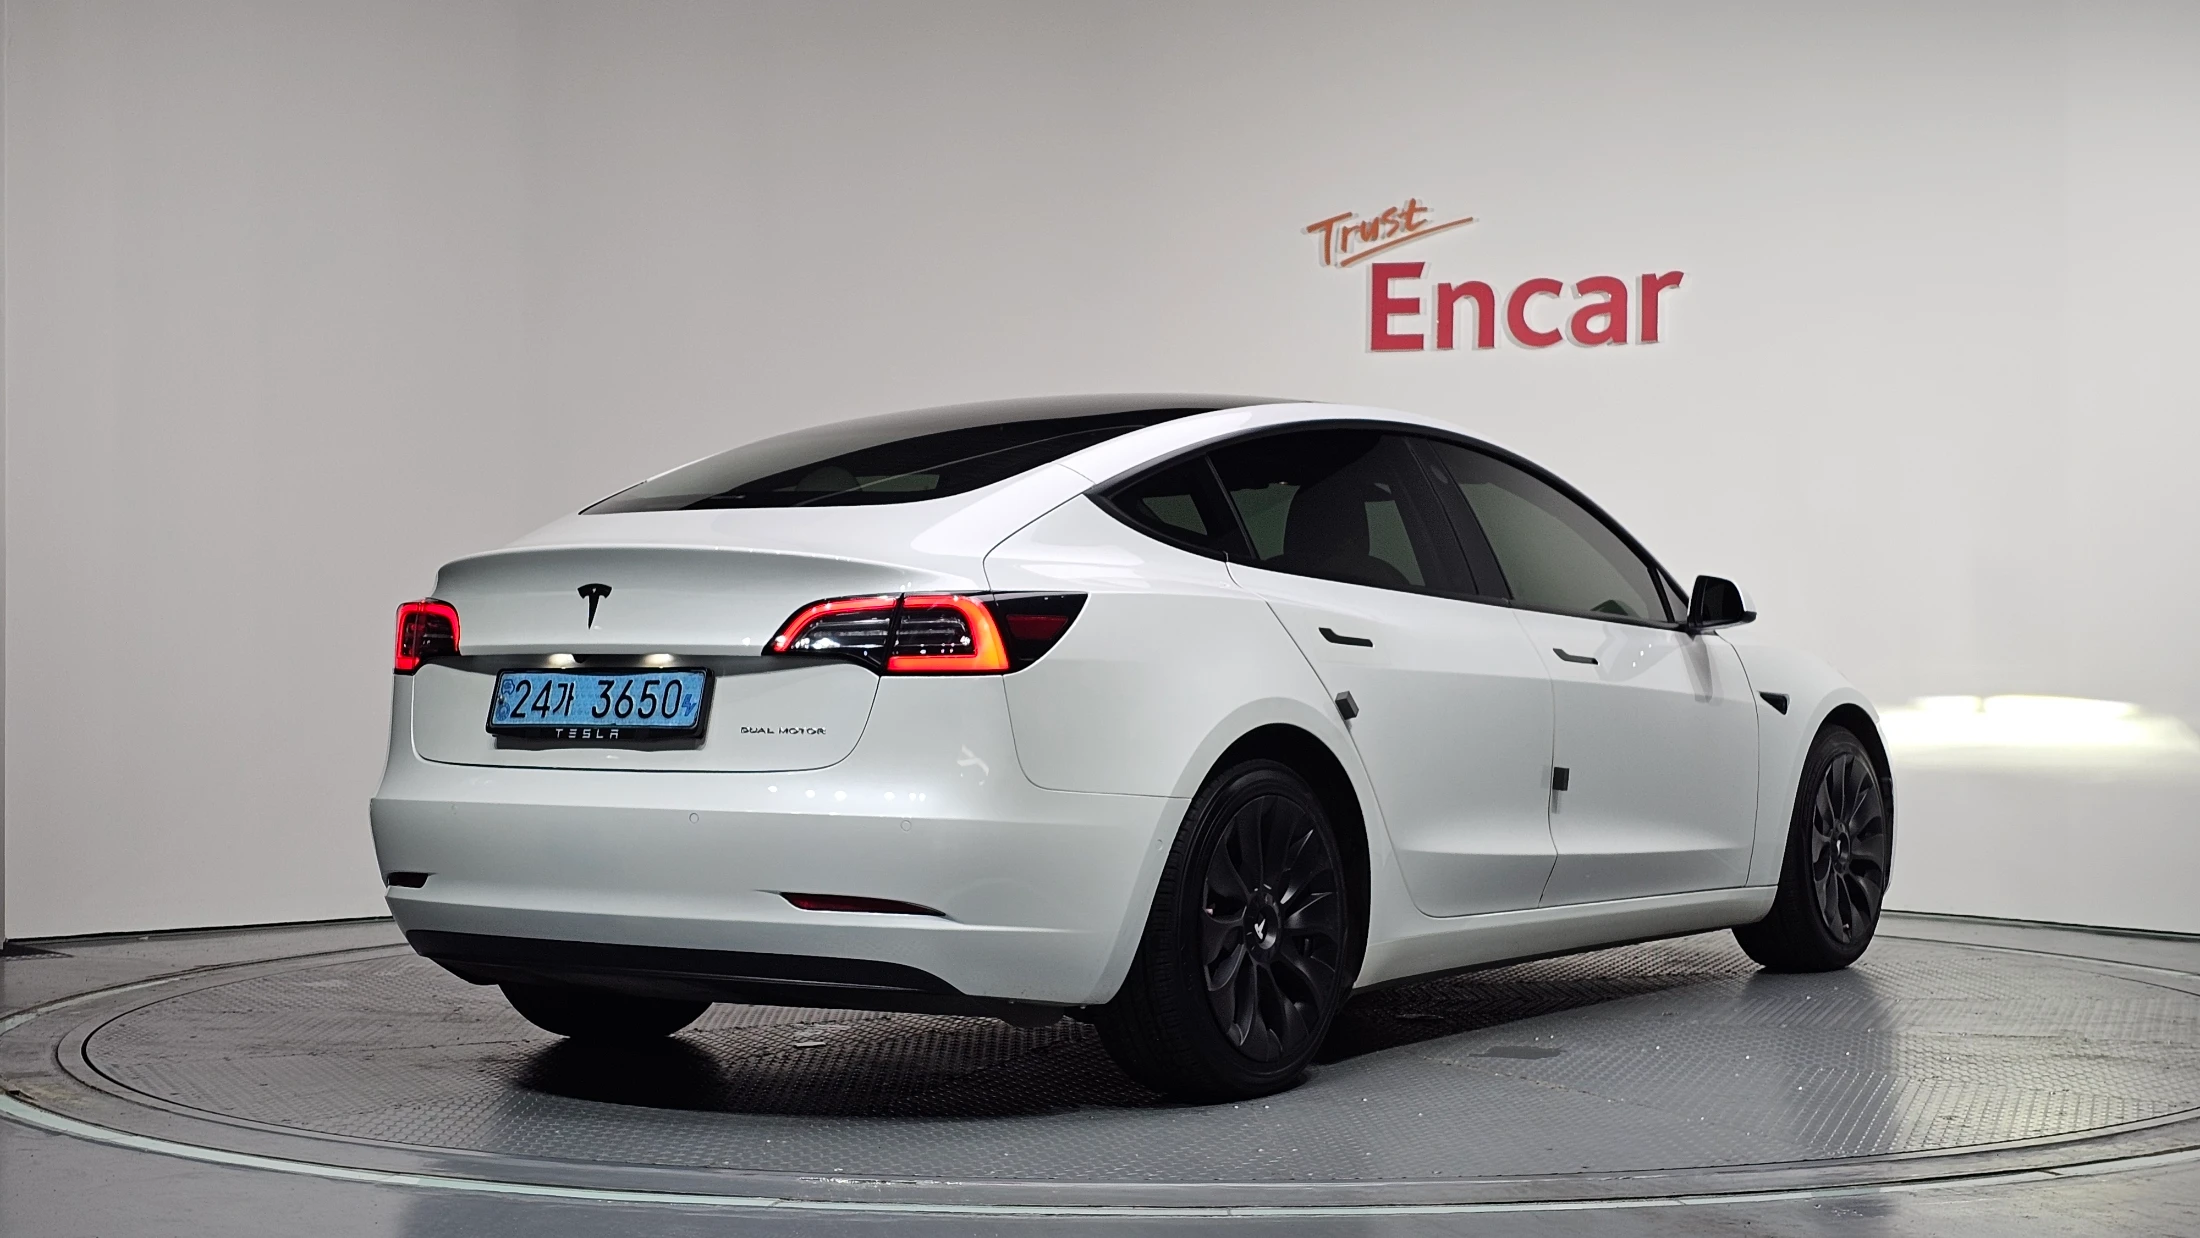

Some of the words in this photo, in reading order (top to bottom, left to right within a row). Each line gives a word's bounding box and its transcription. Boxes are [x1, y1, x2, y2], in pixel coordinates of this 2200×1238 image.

[1307, 198, 1428, 266] Trust
[1370, 261, 1685, 352] Encar
[510, 679, 575, 719] 24가
[591, 679, 683, 719] 3650
[555, 728, 619, 740] TESLA
[740, 726, 775, 734] DUAL
[778, 727, 827, 735] MOTOR
